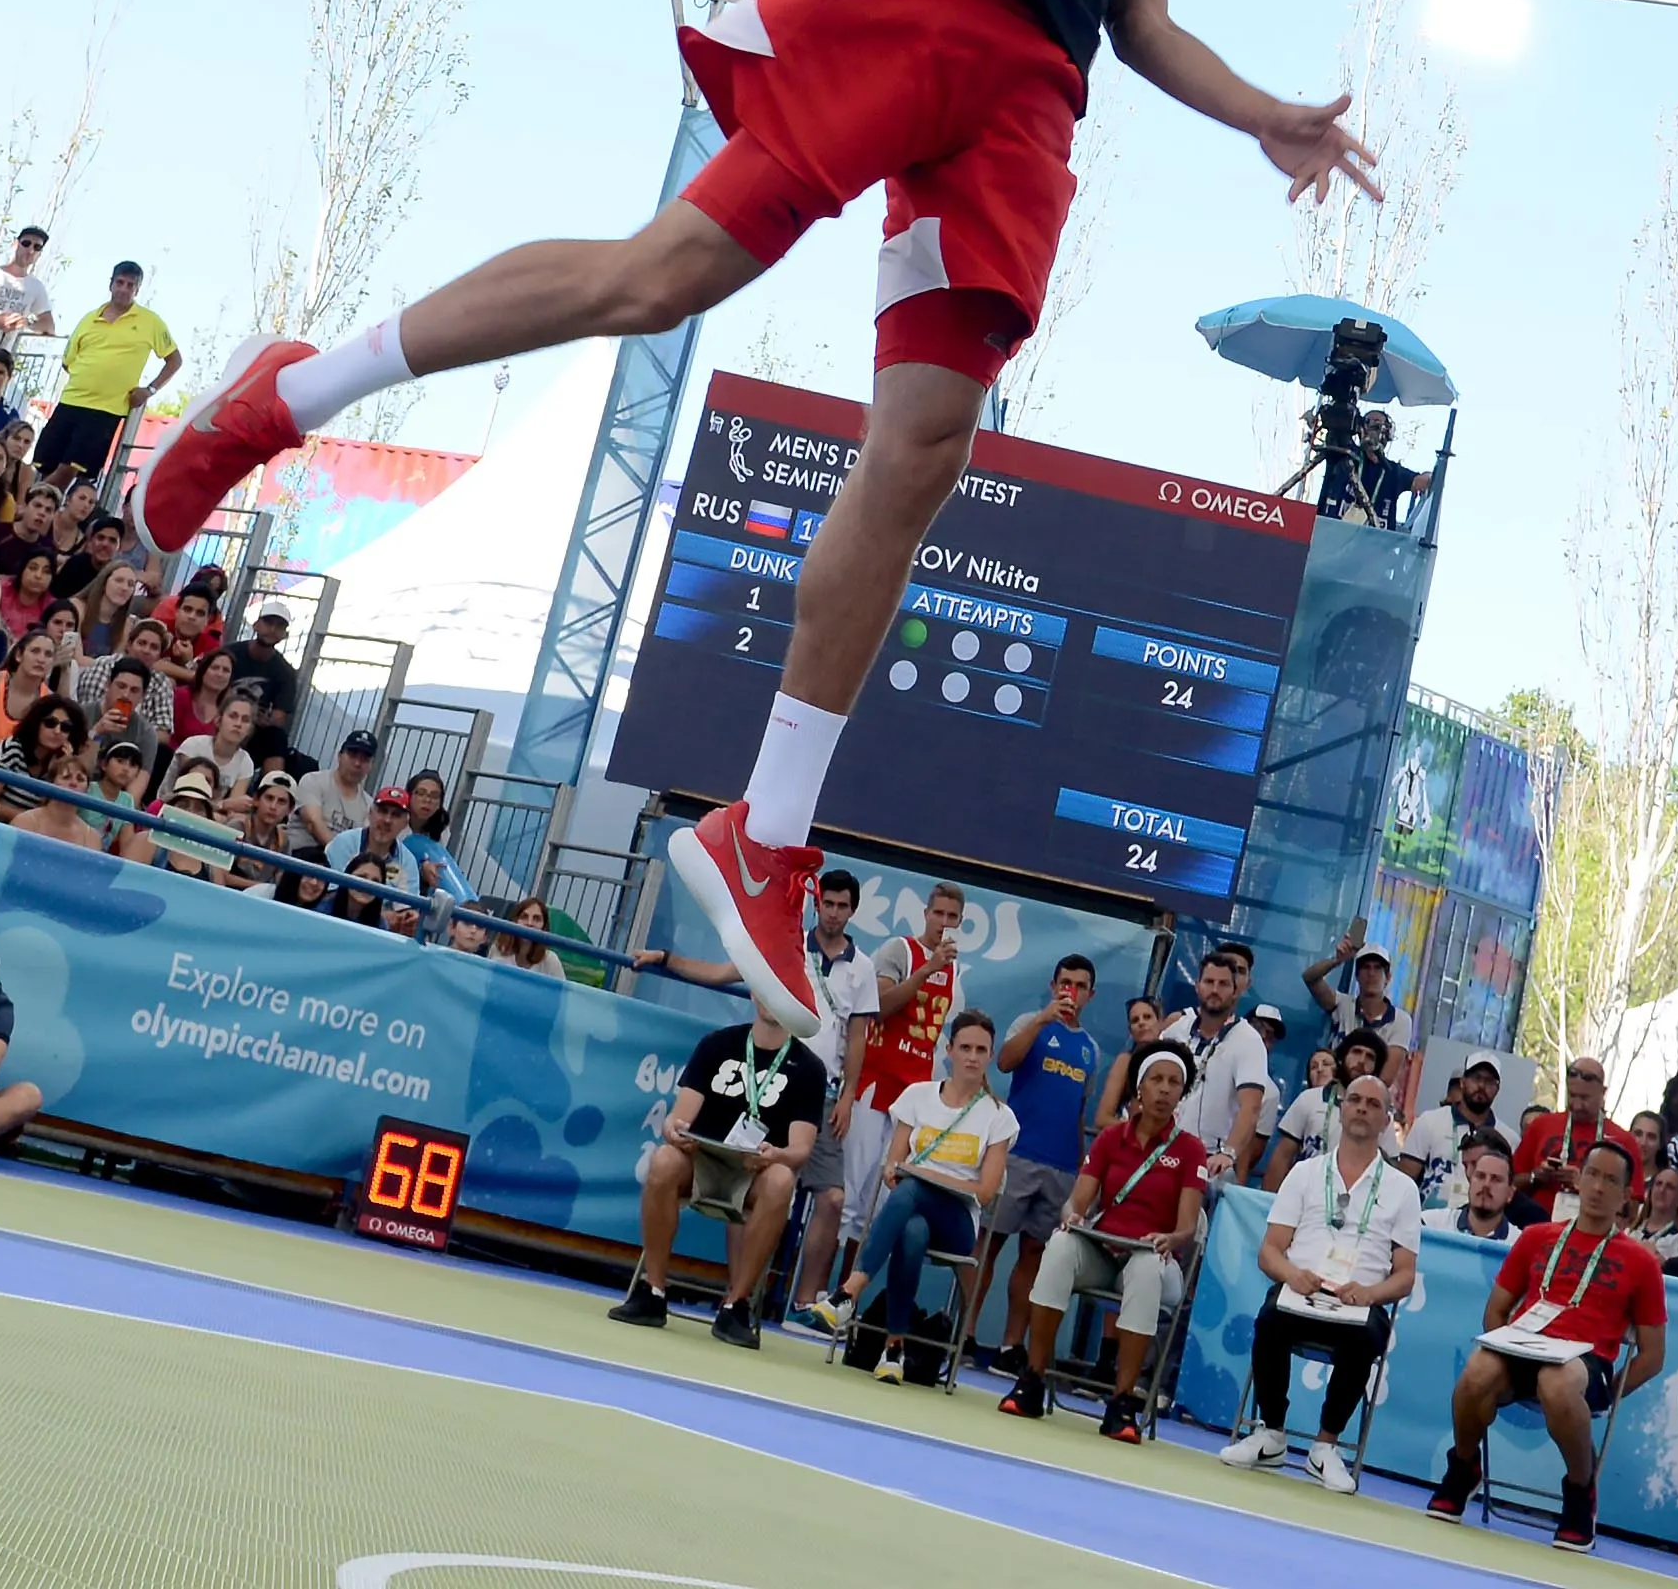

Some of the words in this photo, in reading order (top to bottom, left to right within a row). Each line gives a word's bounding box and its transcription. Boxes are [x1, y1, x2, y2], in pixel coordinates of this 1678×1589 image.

[769, 432, 839, 465] MEN'S
[954, 476, 1022, 507] NTEST
[1191, 488, 1285, 527] OMEGA
[692, 493, 742, 524] RUS
[967, 555, 1039, 593] Nikita
[731, 548, 798, 582] DUNK
[913, 590, 1034, 636] ATTEMPTS
[1143, 642, 1227, 679] POINTS
[735, 627, 753, 652] 2
[747, 586, 761, 611] 1
[1161, 680, 1193, 709] 24
[1111, 804, 1187, 843] TOTAL
[1125, 844, 1158, 872] 24
[167, 952, 290, 1014] Explore
[298, 995, 378, 1037] more
[387, 1019, 425, 1049] on
[131, 1002, 430, 1102] olympicchannel.com
[368, 1132, 461, 1218] 68
[386, 1221, 435, 1244] OMEGA
